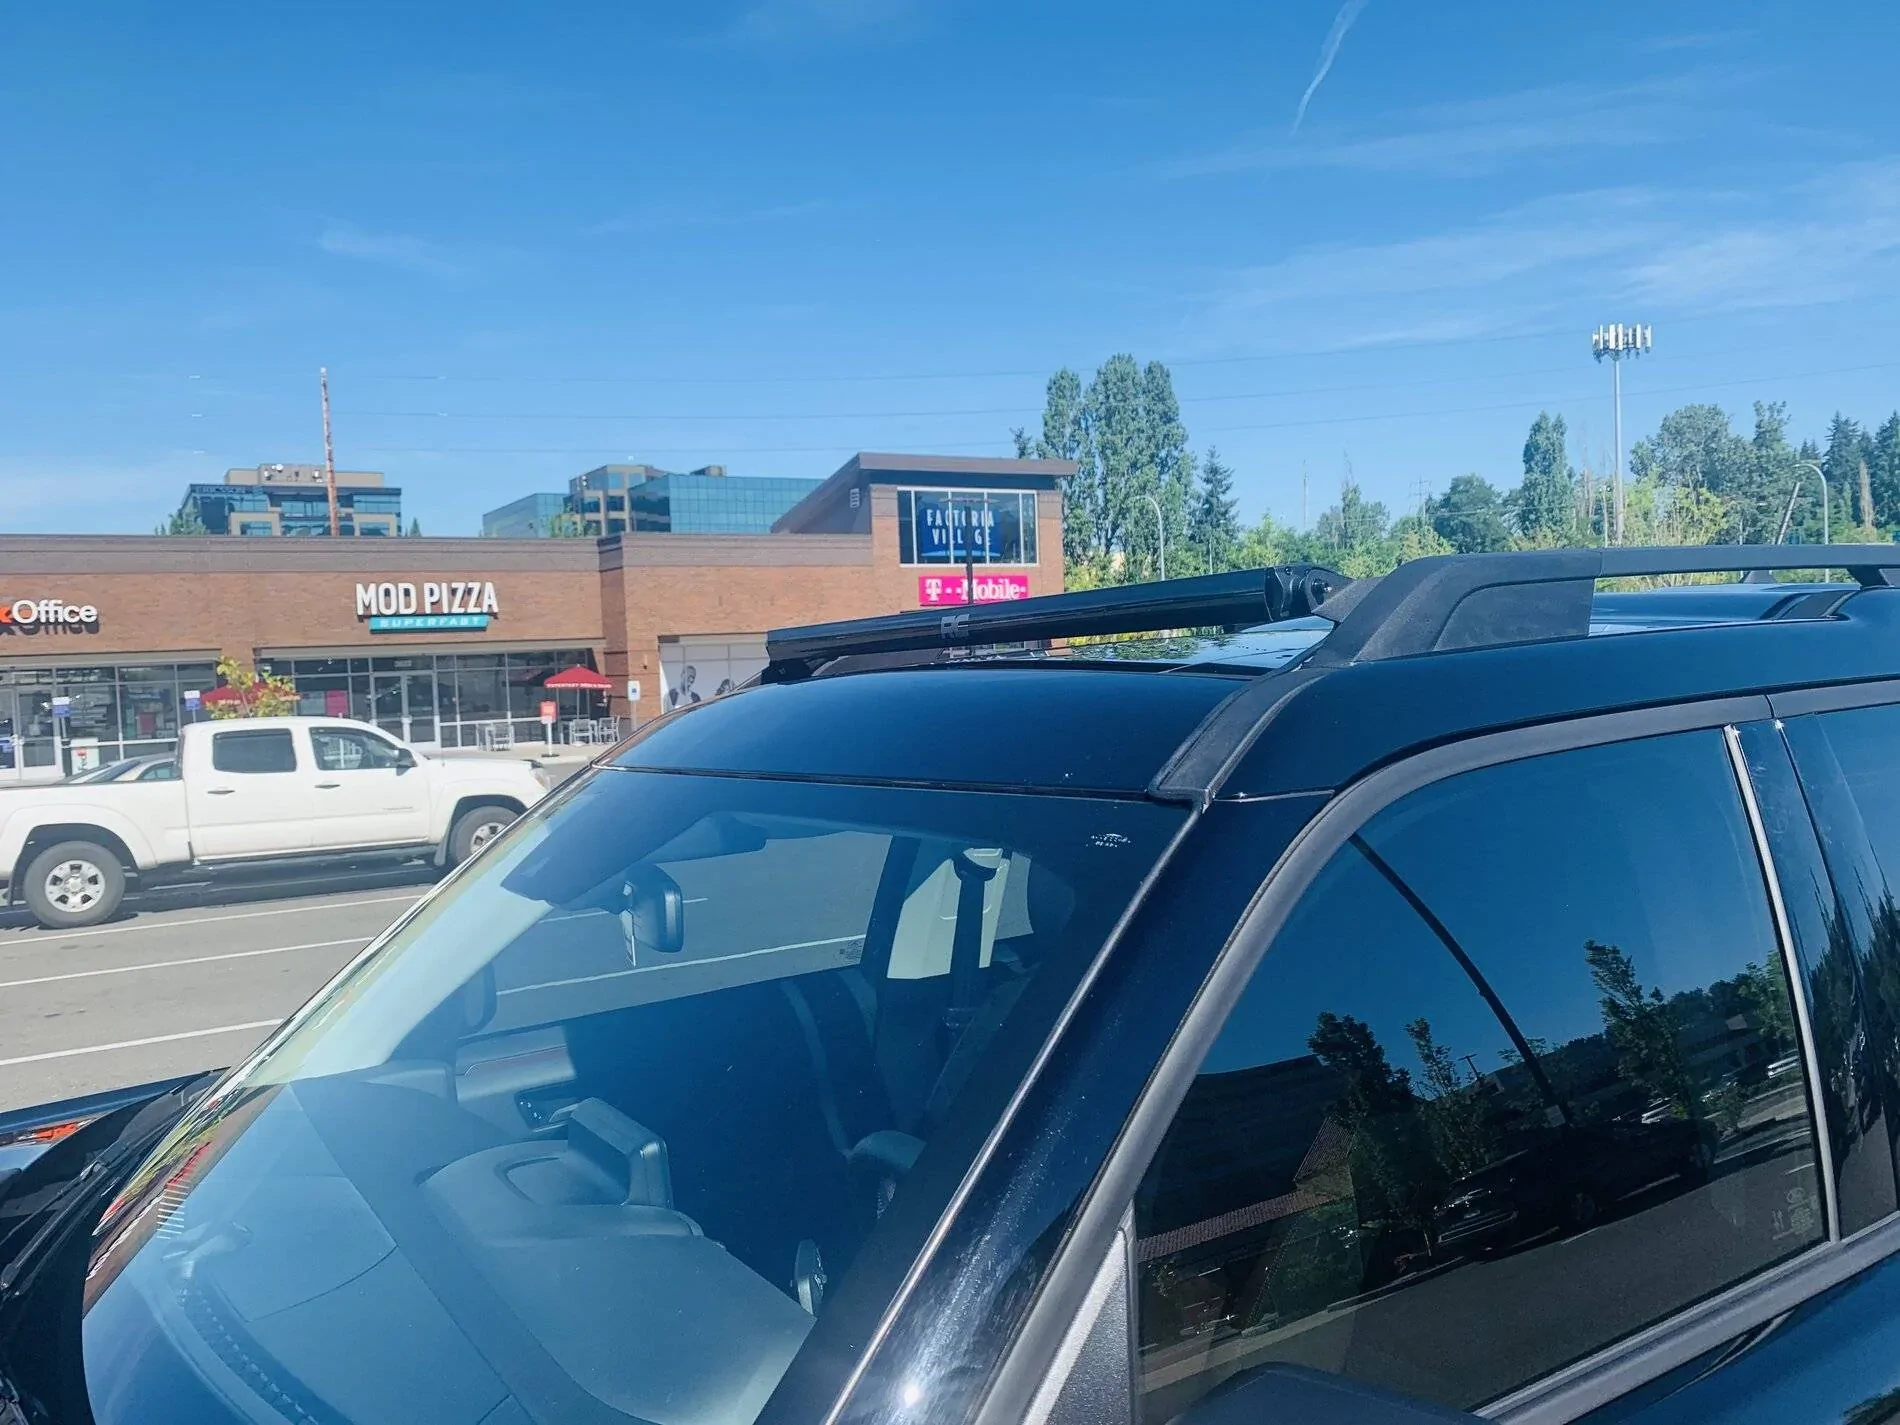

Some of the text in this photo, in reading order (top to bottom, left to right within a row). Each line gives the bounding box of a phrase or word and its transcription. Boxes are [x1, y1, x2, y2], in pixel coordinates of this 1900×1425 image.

[931, 528, 991, 546] VILGE
[355, 581, 499, 615] MOD PIZZA
[12, 599, 98, 624] Office
[380, 616, 481, 629] SUPERFAST
